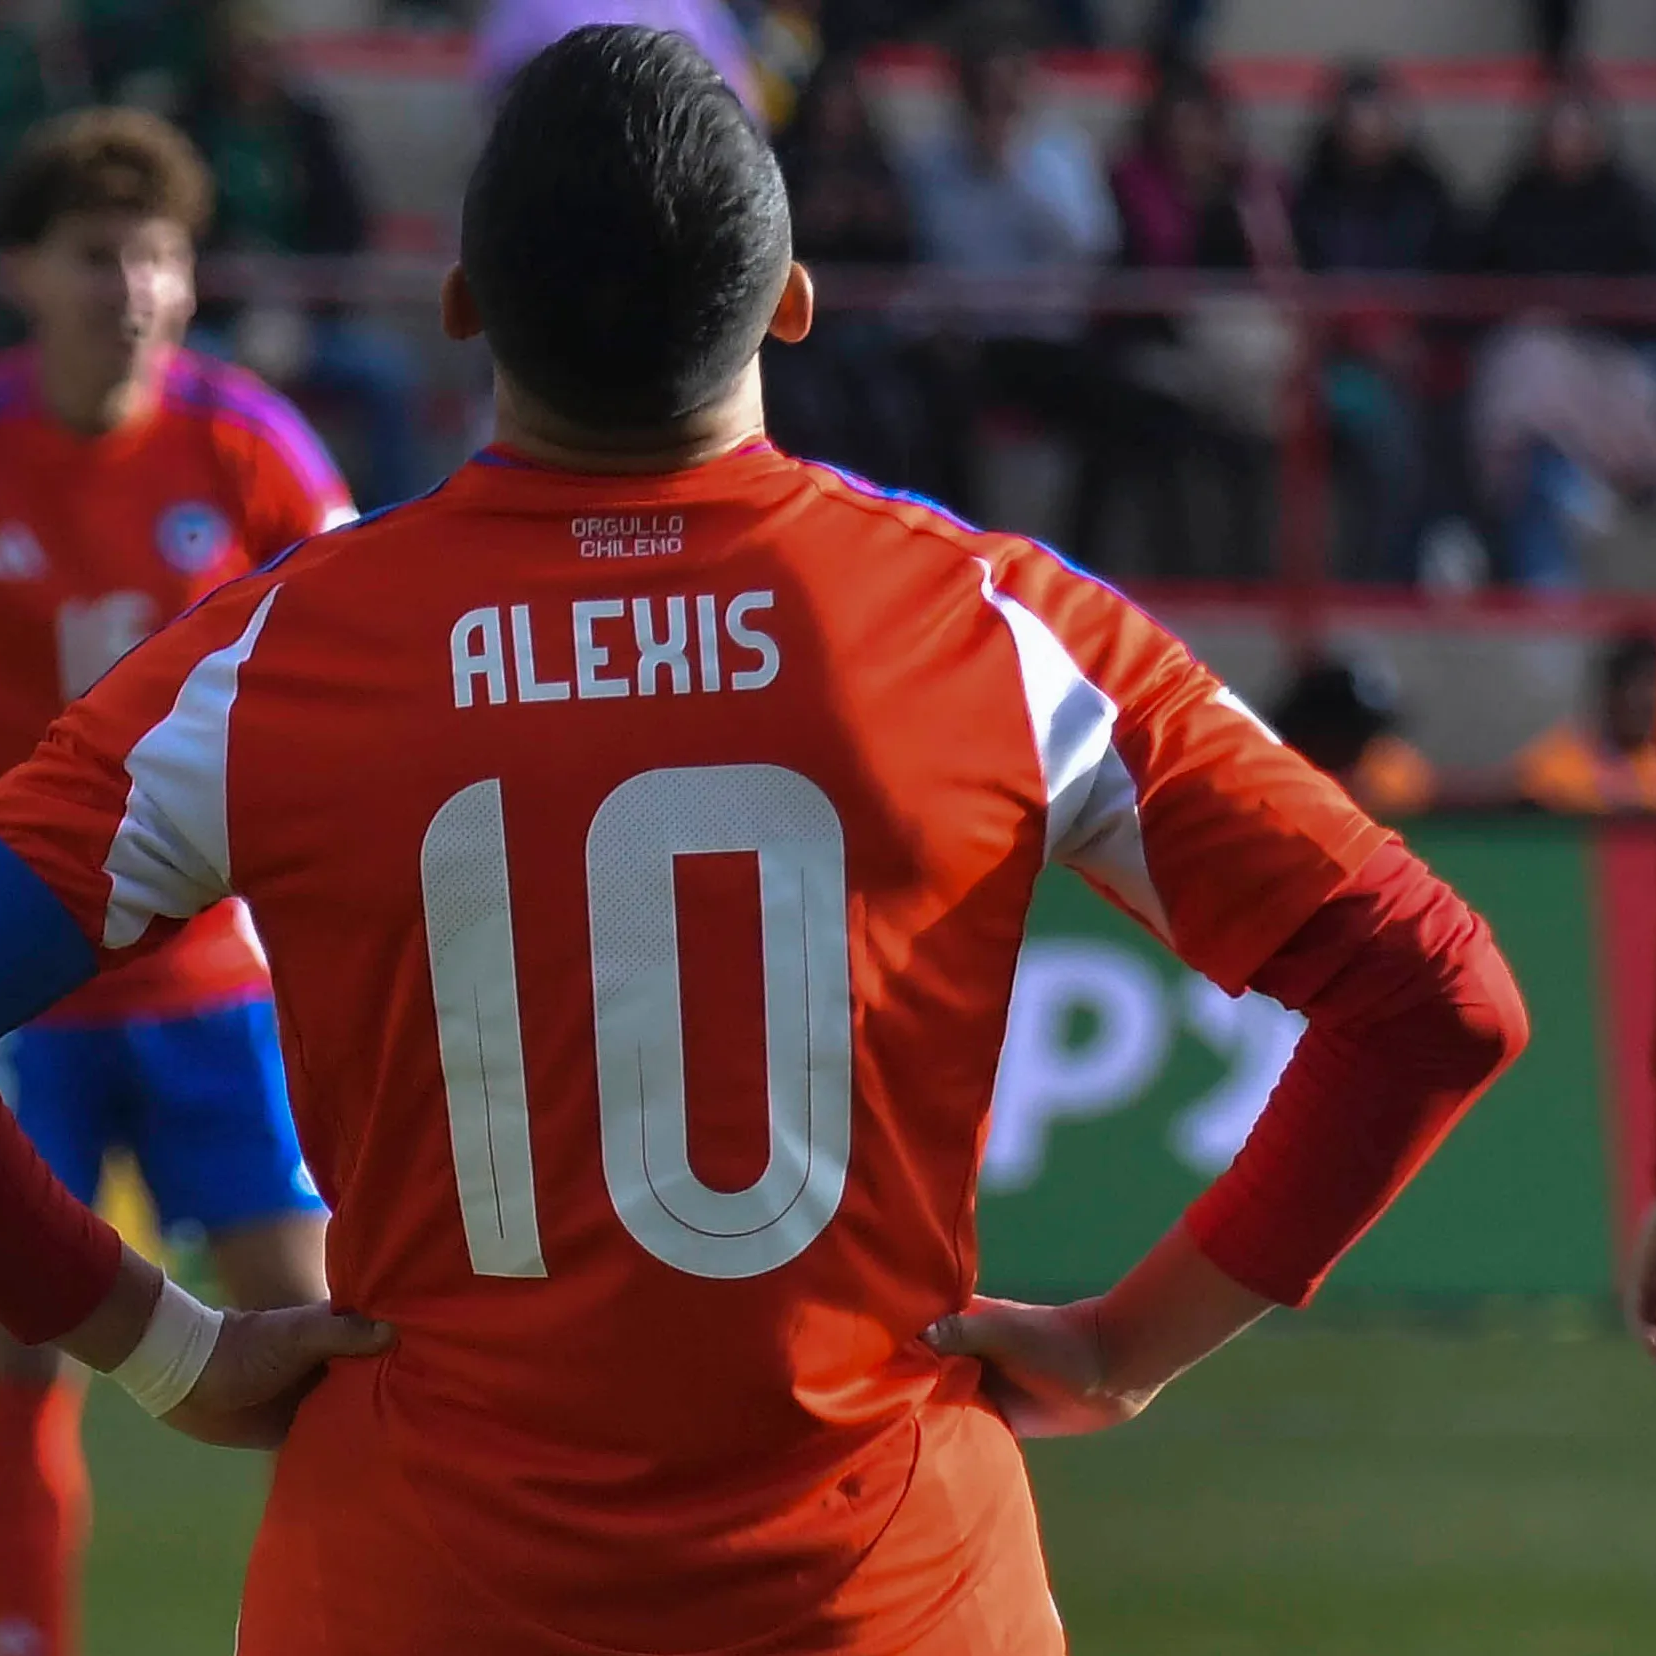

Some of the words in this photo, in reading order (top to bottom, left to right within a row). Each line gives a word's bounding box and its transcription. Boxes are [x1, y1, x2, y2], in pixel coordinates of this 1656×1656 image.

[571, 515, 684, 537] ORGULLO
[580, 538, 682, 558] CHILENO
[450, 591, 780, 708] ALEXIS
[421, 764, 851, 1279] 10
